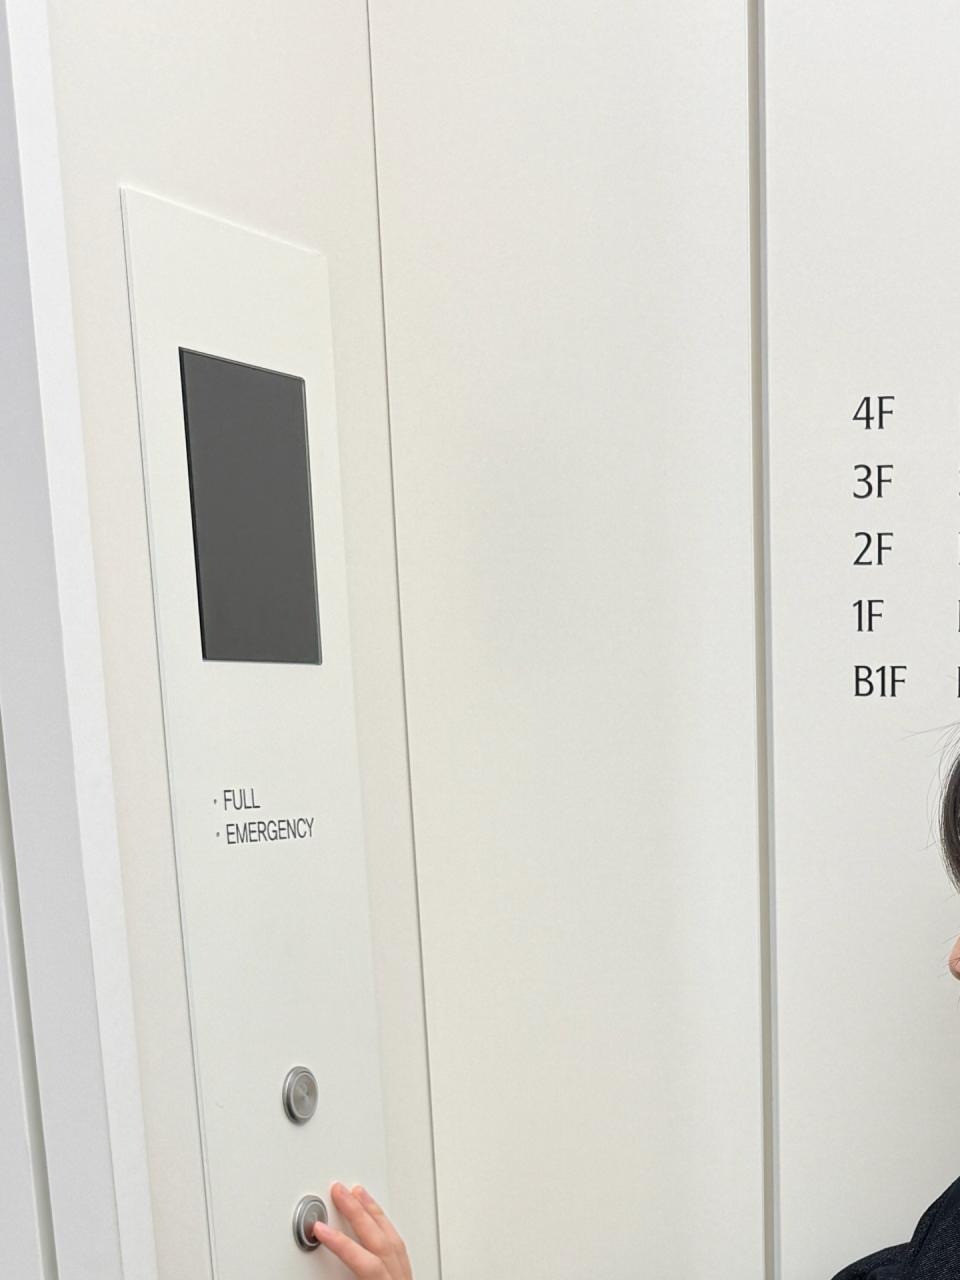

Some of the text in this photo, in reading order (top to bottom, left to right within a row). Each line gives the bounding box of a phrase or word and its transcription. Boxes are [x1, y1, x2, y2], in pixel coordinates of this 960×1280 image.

[852, 395, 895, 430] 4F
[852, 464, 894, 499] 3F
[852, 532, 894, 565] 2F
[852, 600, 884, 632] 1F
[853, 665, 907, 698] B1F
[223, 788, 261, 811] FULL
[225, 817, 314, 845] EMERGENCY
